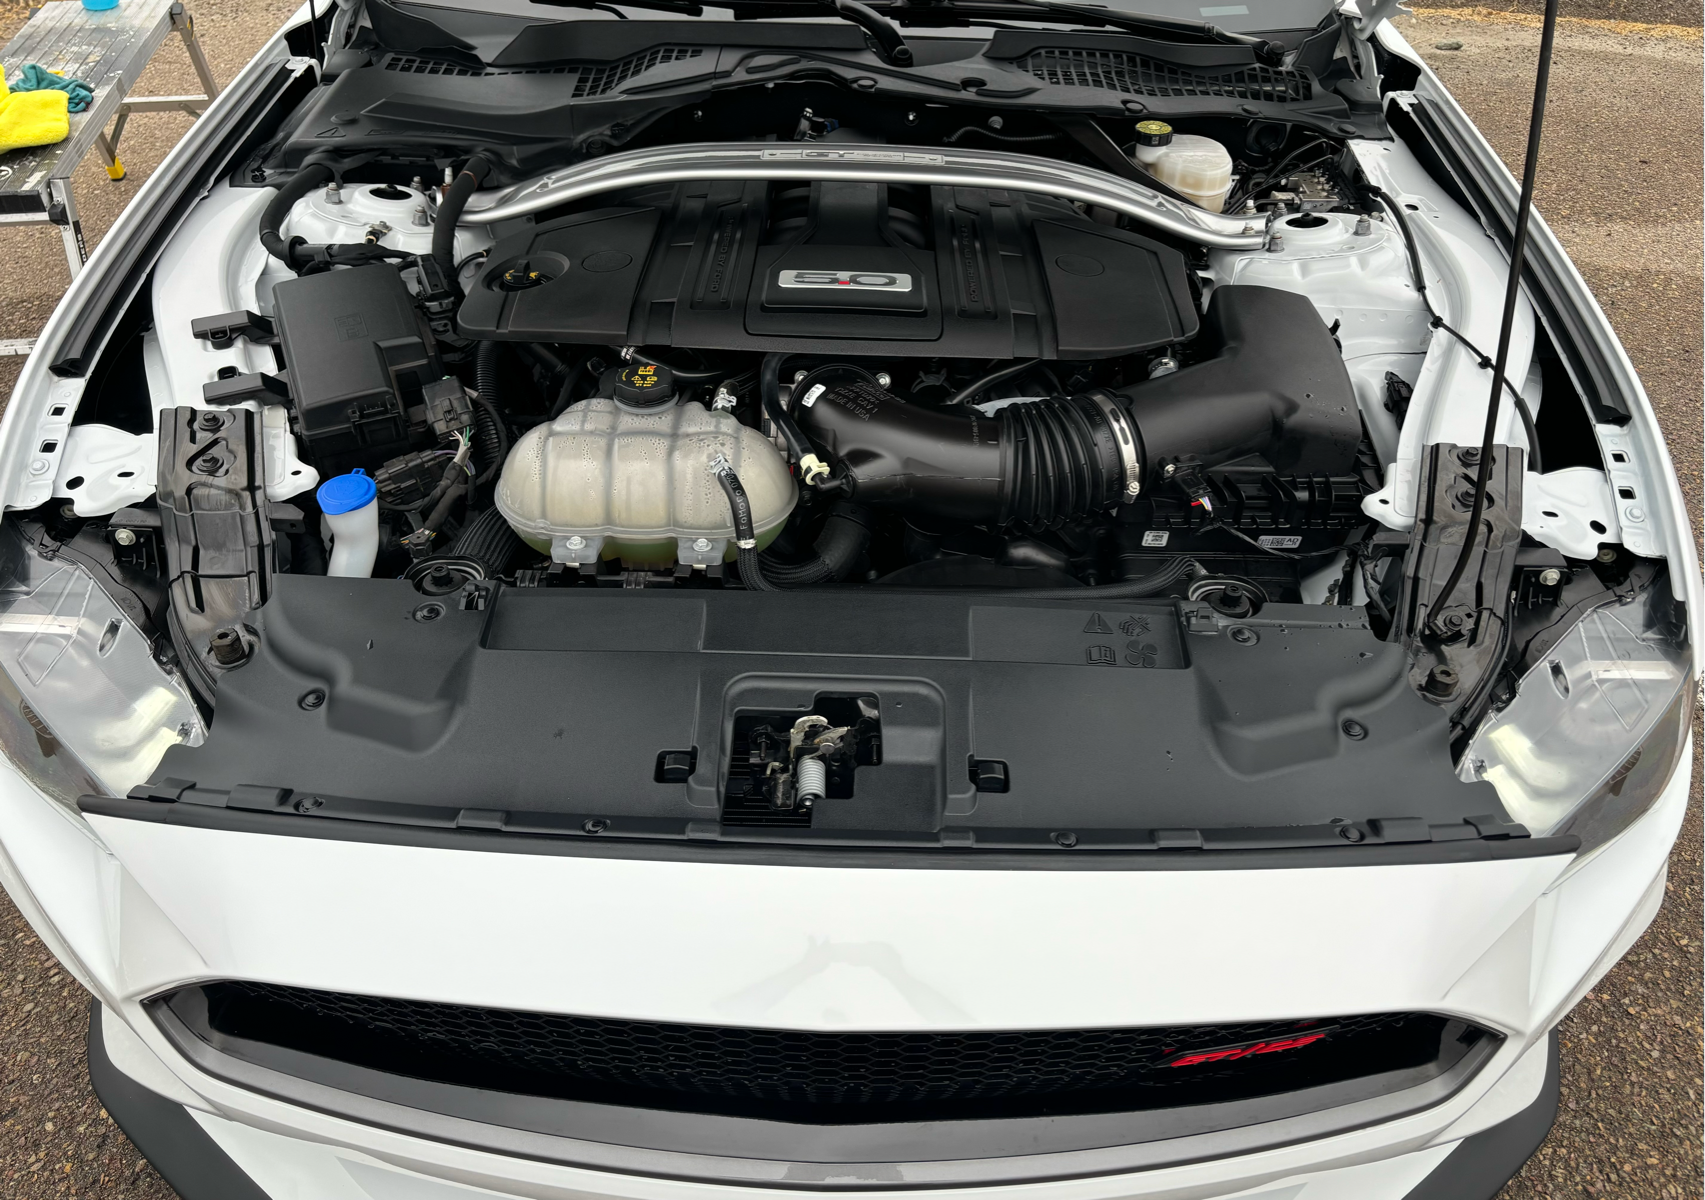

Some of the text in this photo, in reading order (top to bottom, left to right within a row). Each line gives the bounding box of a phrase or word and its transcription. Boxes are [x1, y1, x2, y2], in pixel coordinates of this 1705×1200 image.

[711, 268, 723, 293] FORD
[793, 271, 898, 287] 5.0
[966, 260, 979, 302] POWERED
[826, 393, 845, 405] MADE
[855, 407, 871, 421] USA
